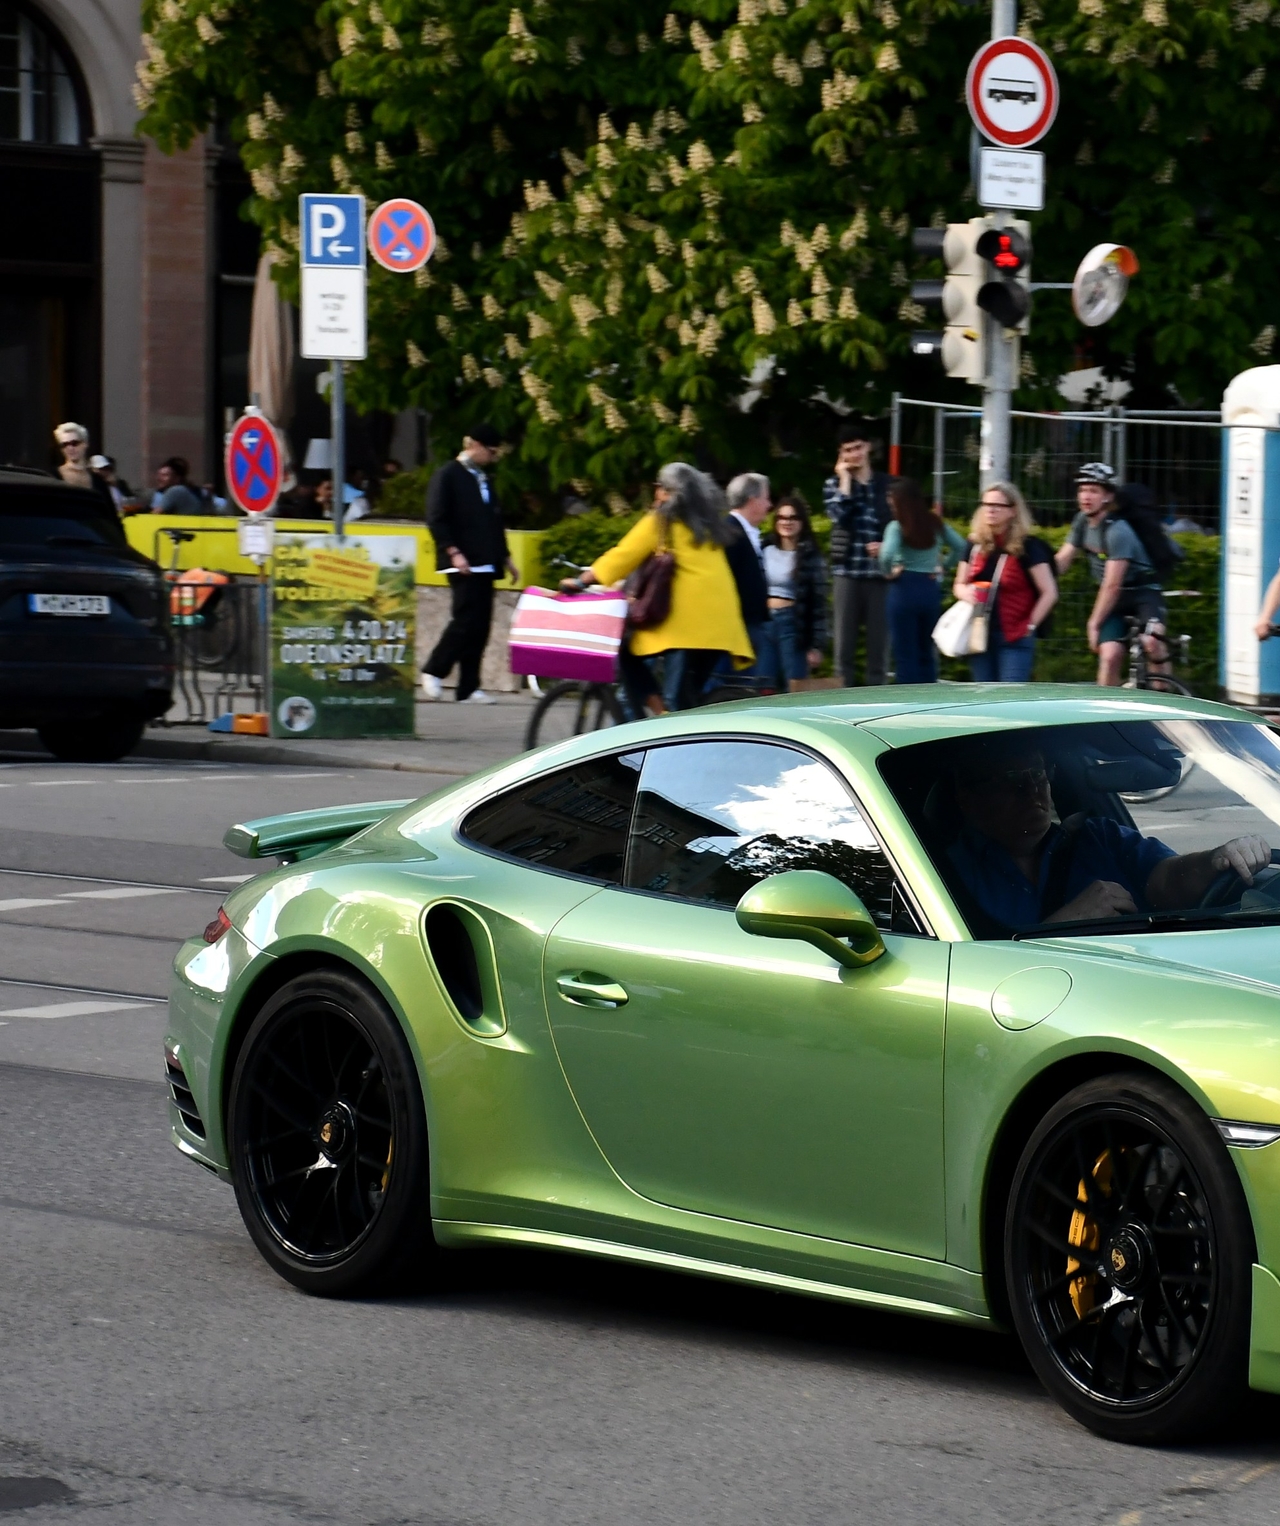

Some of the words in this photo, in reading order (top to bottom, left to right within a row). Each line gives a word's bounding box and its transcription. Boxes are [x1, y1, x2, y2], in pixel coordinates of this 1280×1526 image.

[310, 204, 346, 257] P
[282, 627, 336, 640] SAMSTAG
[280, 643, 406, 664] ODEONSPLATZ
